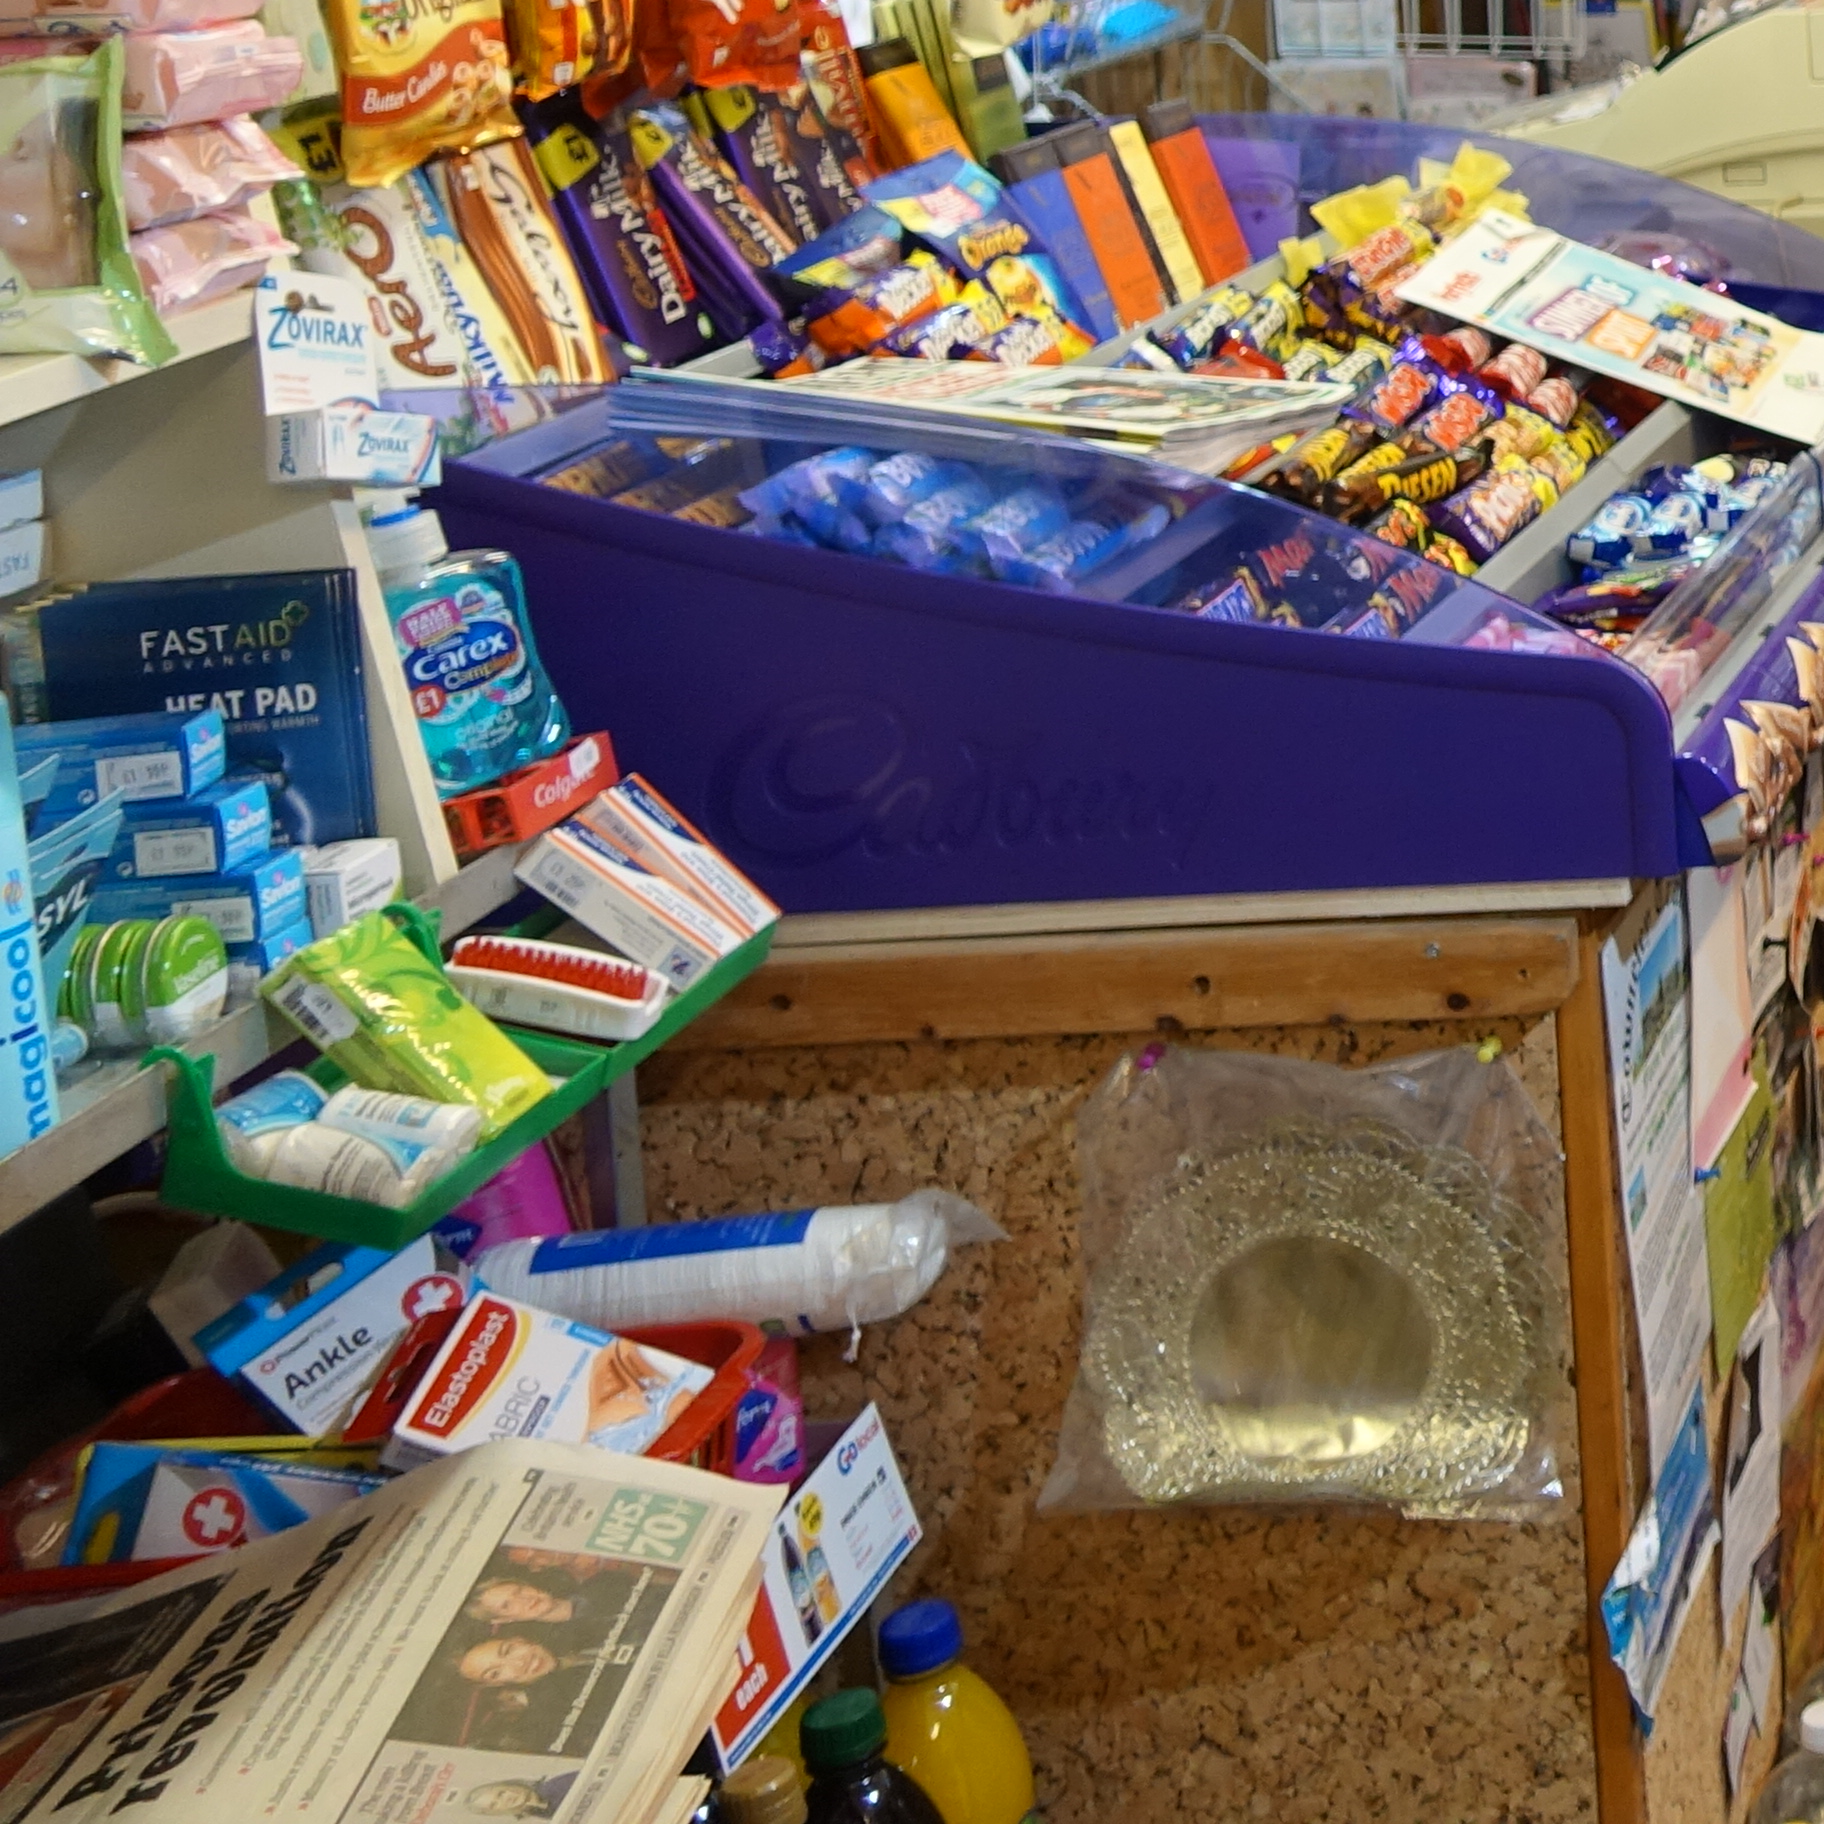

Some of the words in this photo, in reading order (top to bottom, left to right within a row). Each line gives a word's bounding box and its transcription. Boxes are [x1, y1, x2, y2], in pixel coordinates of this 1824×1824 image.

[341, 205, 458, 377] Aero
[268, 306, 366, 350] ZOVIRAX
[357, 430, 410, 458] ZOVIRAX
[142, 647, 295, 674] ADVANCED
[413, 632, 509, 684] Carex
[165, 688, 246, 722] HEAT
[255, 682, 320, 716] PAD
[414, 690, 443, 717] £1
[282, 1324, 372, 1400] Ankle
[422, 1309, 510, 1430] Elastoplast
[493, 1375, 544, 1446] ABRIC
[591, 1493, 646, 1557] NHS
[108, 1515, 375, 1817] revolution
[735, 1661, 770, 1712] each
[50, 1587, 272, 1814] Prisons
